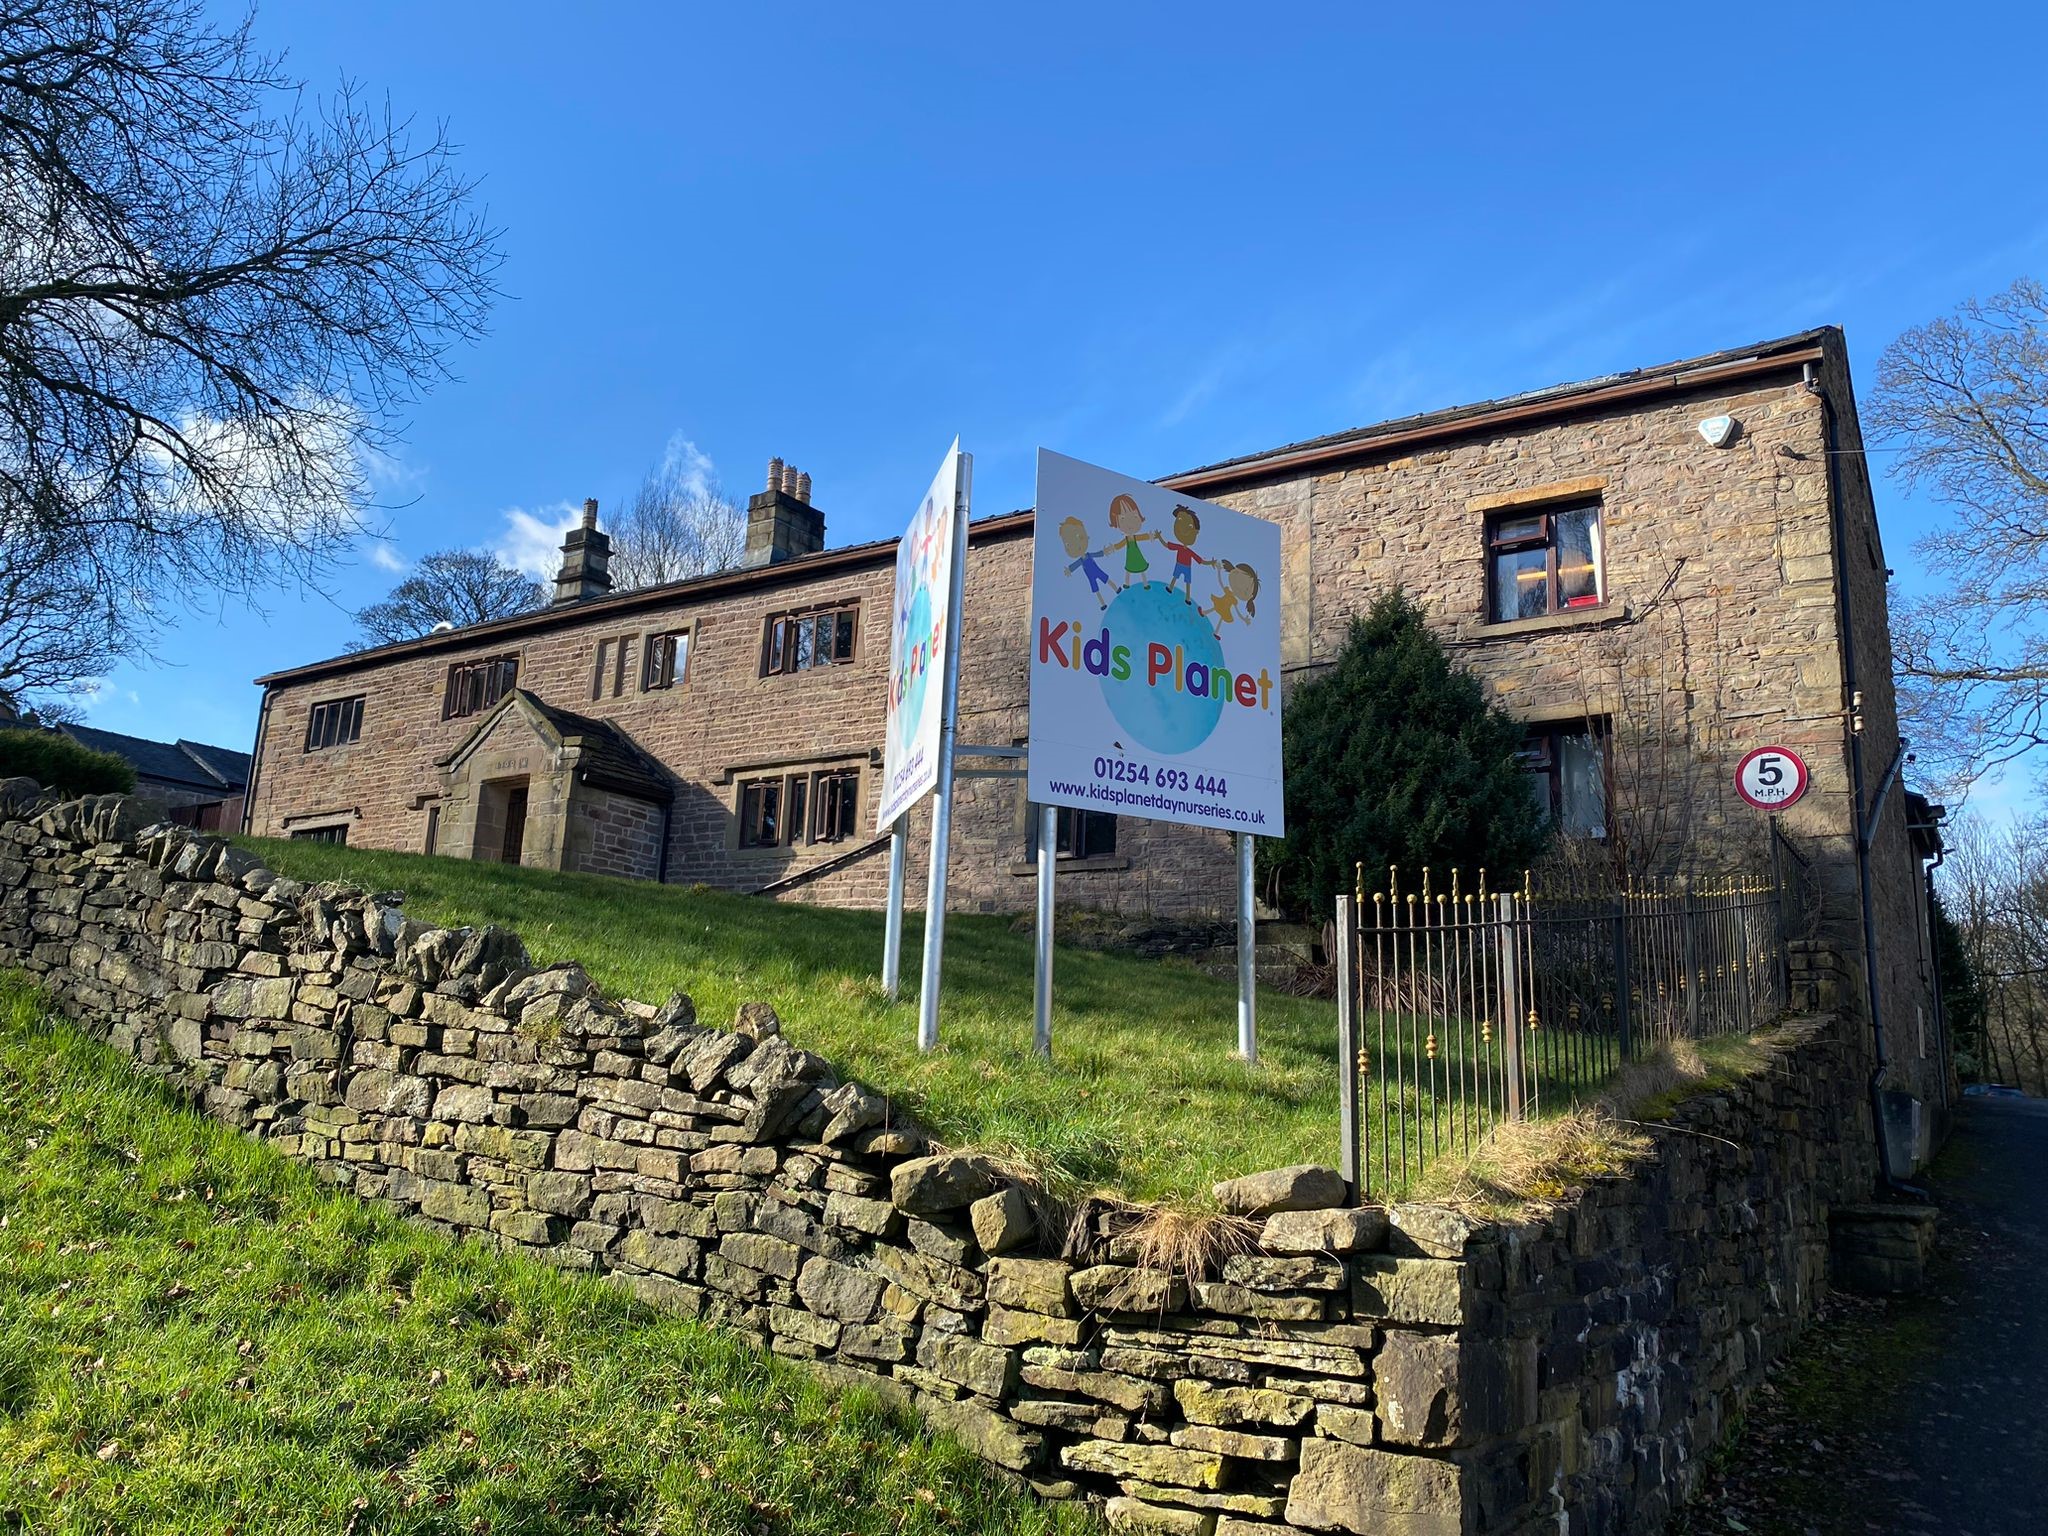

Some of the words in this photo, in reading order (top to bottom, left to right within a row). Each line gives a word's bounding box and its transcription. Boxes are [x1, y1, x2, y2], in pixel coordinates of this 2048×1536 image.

[1039, 616, 1132, 681] Kids
[1147, 642, 1274, 711] Planet
[1094, 756, 1150, 785] 01254
[1155, 767, 1189, 792] 693
[1194, 774, 1228, 798] 444
[1755, 787, 1789, 797] M.P.H.
[1758, 757, 1783, 786] 5
[1049, 780, 1266, 825] www.kidsplanetdaynurseries.co.uk
